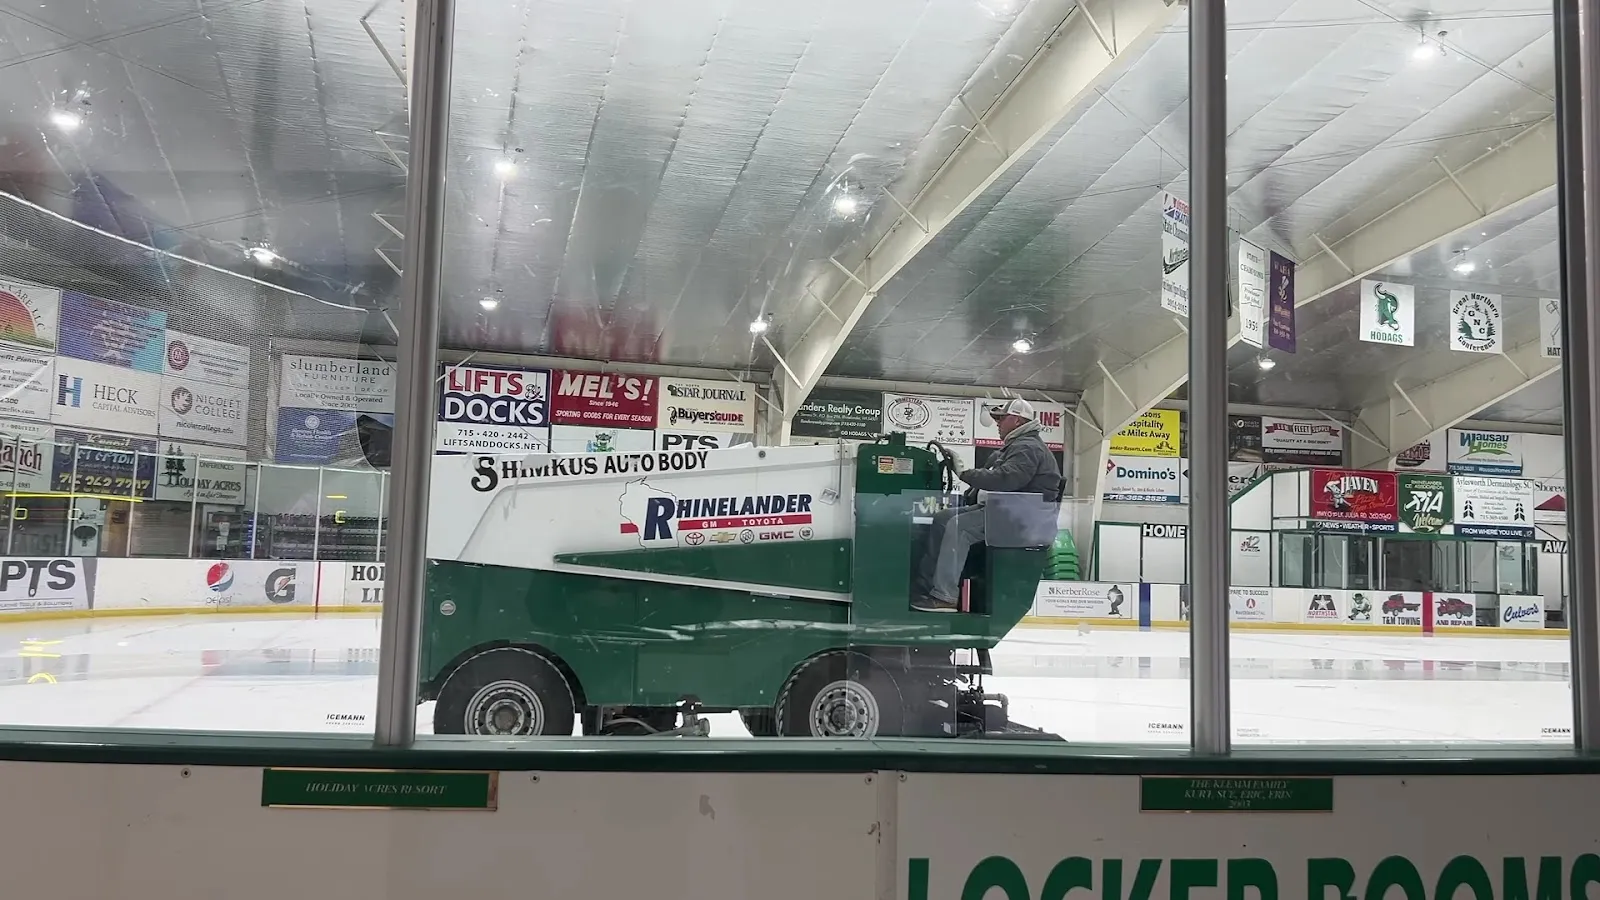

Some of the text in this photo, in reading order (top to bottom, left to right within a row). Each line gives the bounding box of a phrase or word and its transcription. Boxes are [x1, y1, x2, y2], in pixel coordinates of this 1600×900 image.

[1452, 292, 1500, 318] Great Northern
[1370, 330, 1403, 344] HODAGS
[1457, 337, 1496, 352] Conference
[290, 359, 390, 376] slumberland
[304, 372, 376, 384] FURNITURE
[449, 368, 544, 401] LIFTS &
[557, 373, 654, 401] MEL'S!
[677, 387, 746, 401] STAR JOURNAL
[94, 384, 138, 405] HECK
[320, 393, 344, 401] Owned
[352, 395, 383, 404] Operated
[196, 395, 241, 409] NICOLET
[92, 402, 156, 419] CAPITAL ADVISORS
[195, 405, 241, 420] COLLEGE
[444, 397, 544, 425] DOCKS
[555, 410, 652, 423] SPORTING GOODS FOR EVERY SEASON
[828, 403, 881, 418] Realty Group
[458, 429, 529, 440] 715 420 2442
[1127, 429, 1170, 441] Miles Away
[1460, 432, 1509, 447] Wausau
[443, 438, 542, 450] LIFTSANDDOCKS.NET
[1468, 440, 1508, 453] Homes
[200, 462, 235, 470] ONFERENCES
[471, 451, 708, 492] SHIMKUS AUTO BODY
[1116, 466, 1176, 481] Domino's
[211, 480, 242, 492] ACRES
[1340, 476, 1378, 494] HAVEN
[1456, 478, 1486, 488] Aylesworth
[1523, 481, 1532, 489] SC
[643, 494, 812, 541] RHINELANDER
[702, 517, 784, 529] GM TOYOTA
[1412, 513, 1444, 530] Welcome
[759, 531, 794, 540] GMC
[1142, 524, 1186, 538] HOME
[1498, 529, 1510, 537] YOU
[0, 560, 76, 597] PTS
[265, 568, 296, 604] G
[1054, 587, 1100, 596] KerberRose
[206, 595, 233, 605] pepsi
[1503, 603, 1539, 623] Culver's
[1382, 616, 1421, 626] T&M TOWING
[326, 713, 366, 721] ICEMANN
[1148, 722, 1184, 730] ICEMANN
[305, 782, 448, 795] HOLIDAY ACRES RESORT
[1190, 780, 1290, 789] THE KLEMM FAMILY
[1268, 791, 1293, 801] ERIN
[1228, 800, 1252, 809] 2003
